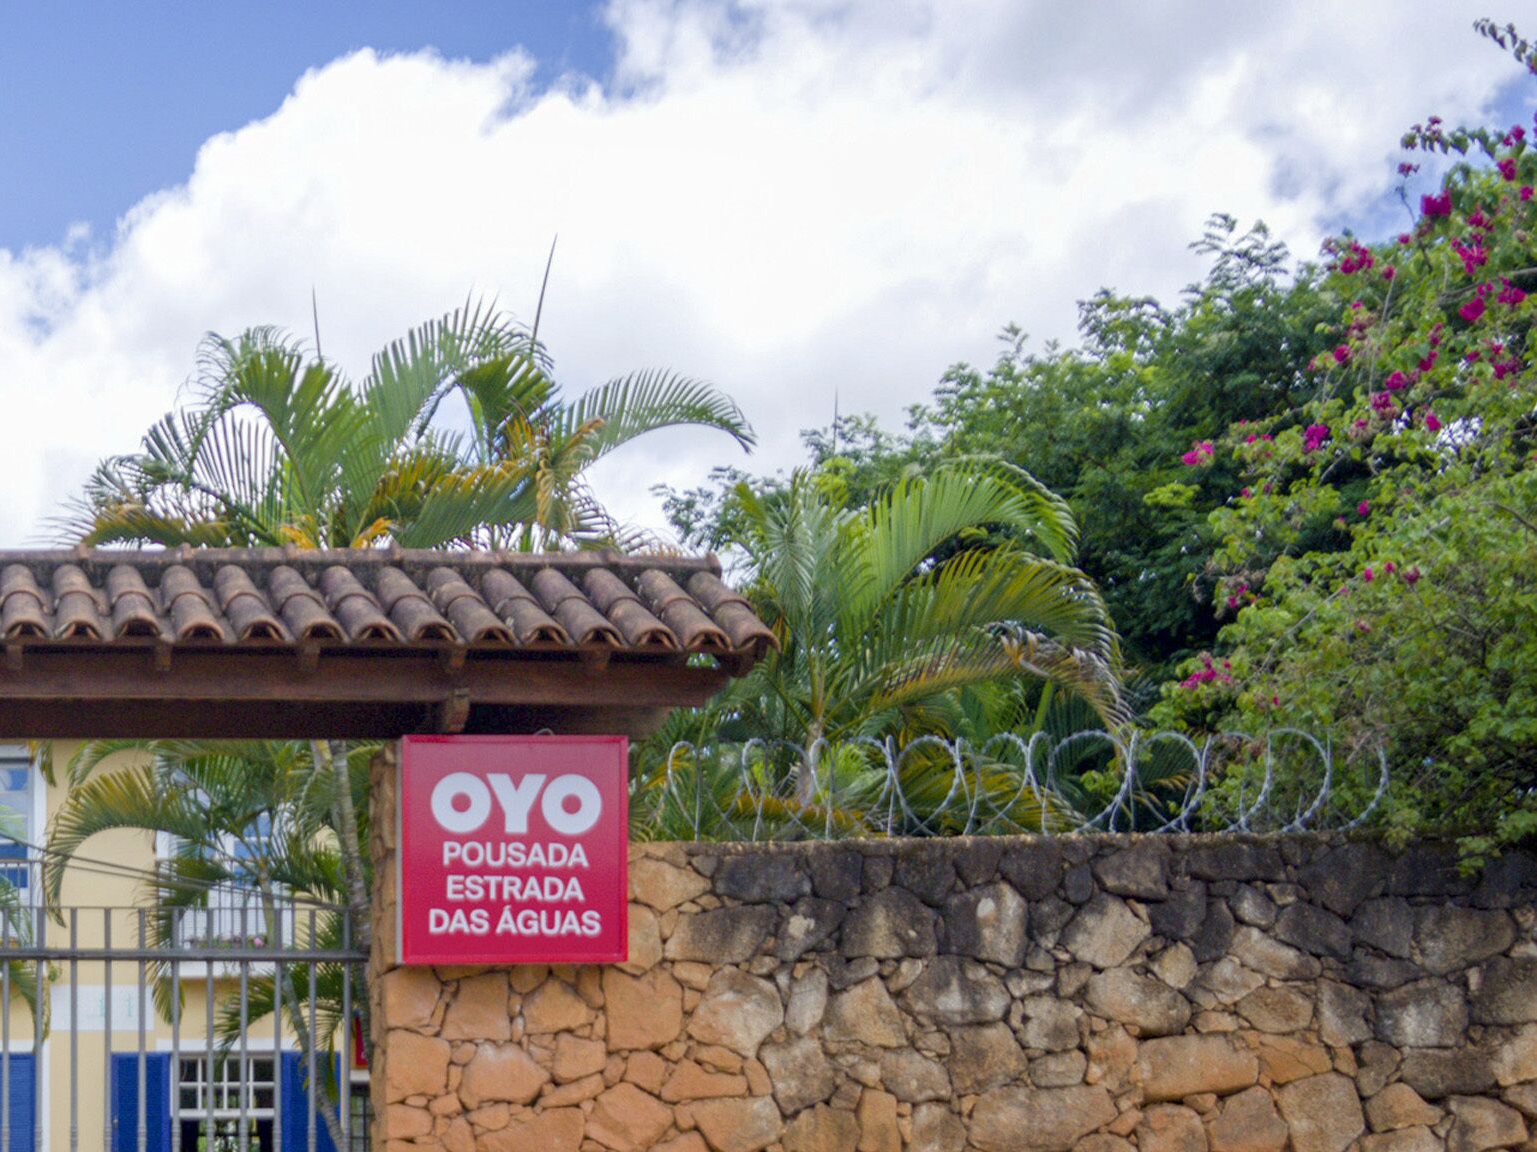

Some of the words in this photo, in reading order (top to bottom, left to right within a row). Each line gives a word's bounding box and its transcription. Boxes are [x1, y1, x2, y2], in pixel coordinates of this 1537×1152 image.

[430, 771, 603, 835] OYO
[442, 841, 589, 868] POUSADA
[446, 874, 585, 901] ESTRADA
[428, 908, 490, 934] DAS
[495, 904, 602, 937] ÁGUAS
